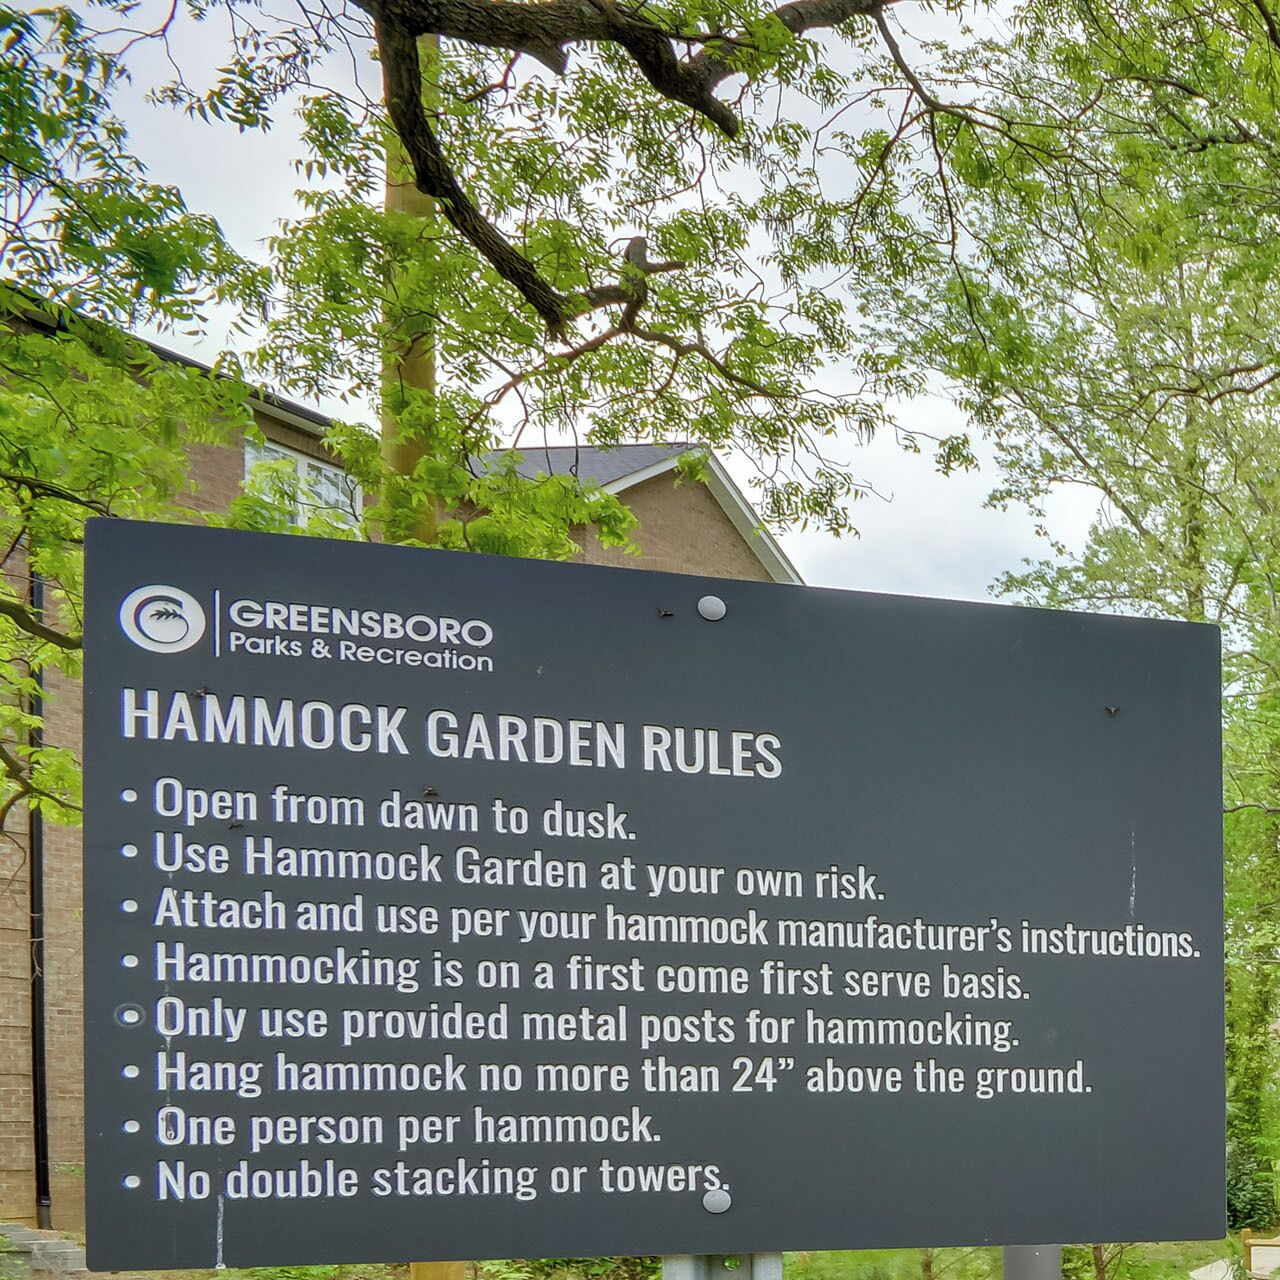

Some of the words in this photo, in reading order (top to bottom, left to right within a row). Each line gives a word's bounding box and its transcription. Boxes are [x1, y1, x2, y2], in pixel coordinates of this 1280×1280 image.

[229, 599, 494, 648] GREENSBORO
[230, 631, 303, 657] Parks
[311, 638, 332, 659] &
[340, 640, 493, 672] Recreation
[123, 688, 410, 755] HAMMOCK
[427, 710, 625, 769] GARDEN
[643, 725, 783, 779] RULES
[155, 777, 257, 827] Open
[271, 785, 365, 826] from
[380, 791, 479, 832] dawn
[491, 799, 529, 835] to
[543, 800, 636, 840] dusk.
[155, 832, 230, 874] Use
[246, 836, 442, 883] Hammock
[456, 846, 587, 889] Garden
[600, 857, 637, 891] at
[646, 865, 725, 898] your
[736, 869, 803, 898] own
[815, 865, 885, 902] risk.
[154, 887, 286, 930] Attach
[296, 894, 364, 932] and
[377, 905, 439, 935] use
[451, 908, 510, 943] per
[518, 910, 597, 943] your
[606, 904, 769, 945] hammock
[1022, 920, 1201, 958] instructions.
[156, 942, 421, 994] Hammocking
[434, 951, 464, 987] is
[477, 960, 520, 989] on
[534, 962, 554, 990] a
[566, 955, 645, 992] first
[656, 965, 749, 994] come
[760, 960, 834, 996] first
[844, 970, 931, 998] serve
[943, 964, 1030, 1000] basis.
[156, 996, 247, 1044] Only
[261, 1009, 328, 1038] use
[343, 1002, 508, 1046] provided
[522, 1005, 627, 1042] metal
[641, 1009, 735, 1050] posts
[745, 1009, 796, 1044] for
[806, 1009, 1019, 1053] hammocking.
[157, 1051, 264, 1098] Hang
[277, 1052, 467, 1091] hammock
[480, 1064, 522, 1091] no
[536, 1064, 629, 1092] more
[641, 1056, 720, 1092] than
[806, 1058, 902, 1093] above
[913, 1059, 965, 1093] the
[975, 1060, 1092, 1100] ground.
[157, 1106, 236, 1146] One
[251, 1116, 383, 1153] person
[398, 1116, 461, 1152] per
[474, 1106, 661, 1143] hammock.
[158, 1160, 210, 1200] No
[226, 1159, 359, 1199] double
[372, 1158, 539, 1201] stacking
[550, 1166, 588, 1193] or
[599, 1158, 730, 1193] towers.
